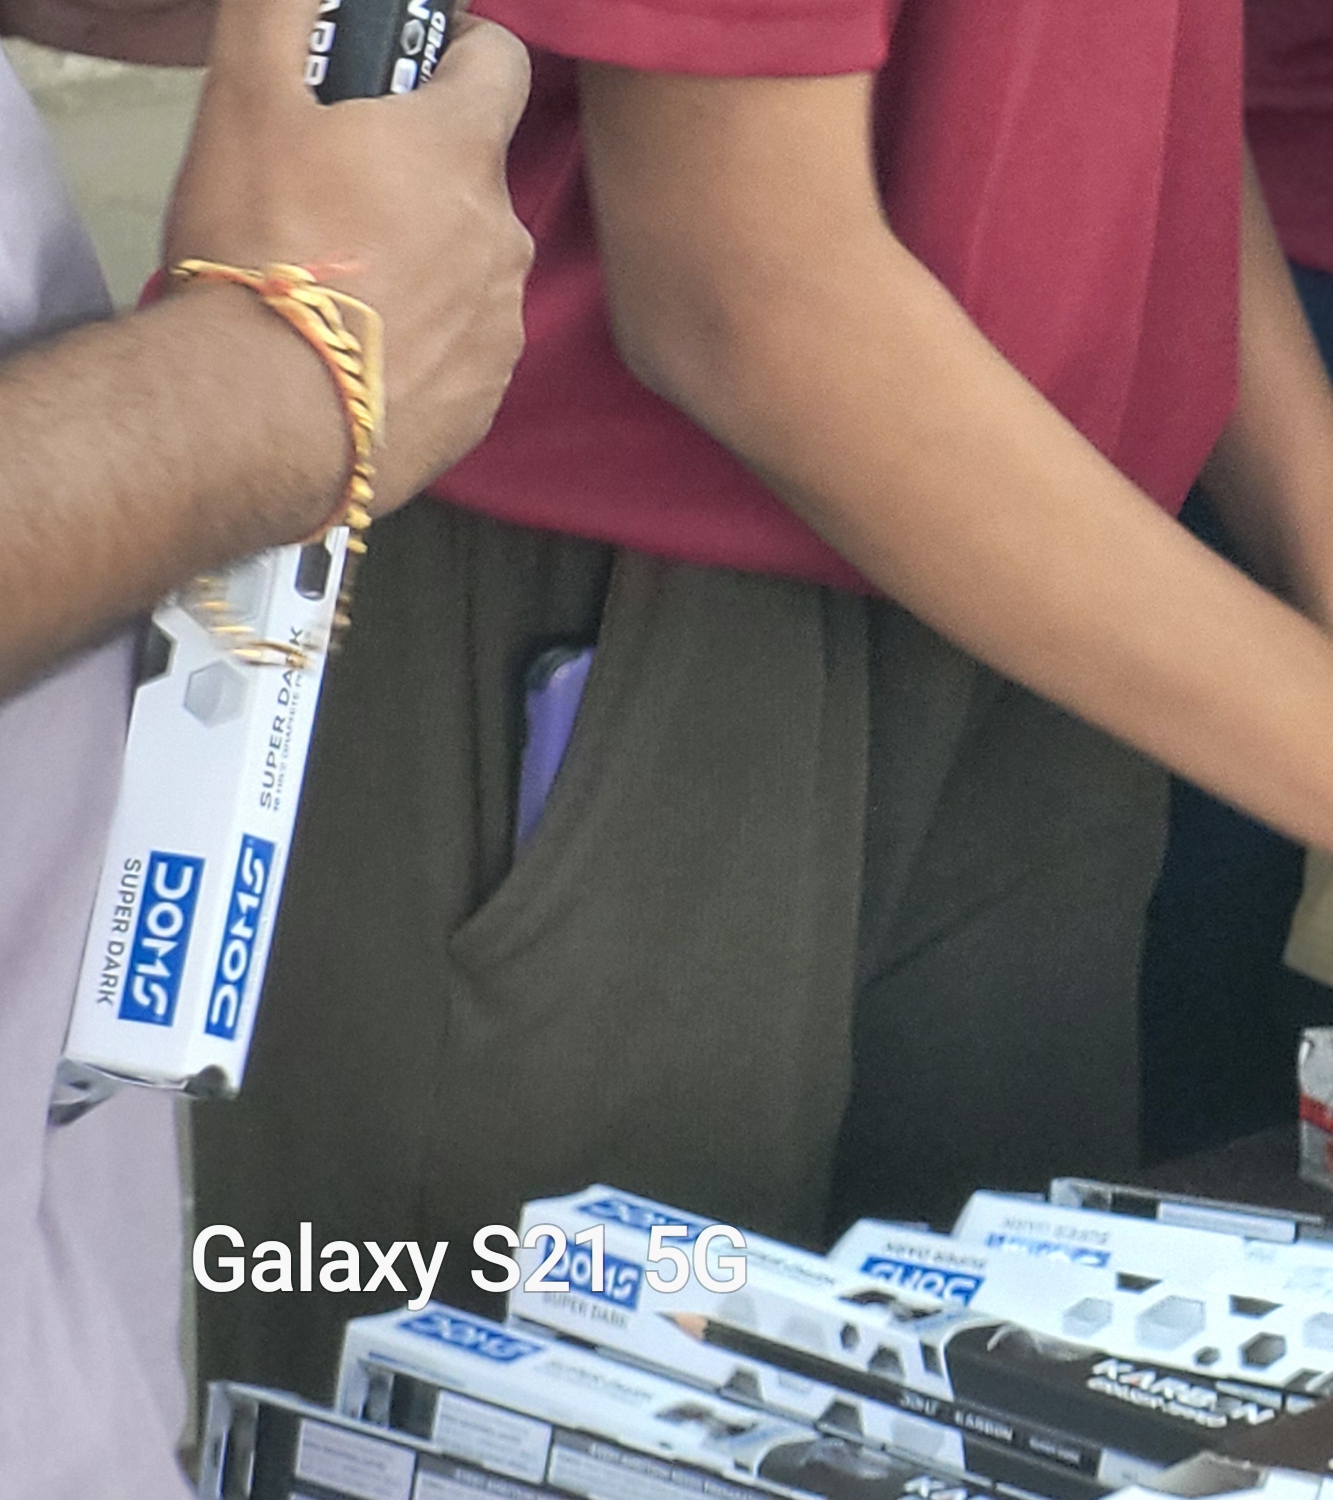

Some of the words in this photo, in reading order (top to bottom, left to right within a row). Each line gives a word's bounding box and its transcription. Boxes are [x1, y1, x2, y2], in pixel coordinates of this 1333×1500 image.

[259, 713, 288, 809] SUPER
[276, 626, 303, 708] DAK
[96, 942, 125, 1007] DARK
[111, 856, 142, 940] SUPER
[132, 861, 195, 1018] DOMS
[209, 846, 269, 1029] DOMS
